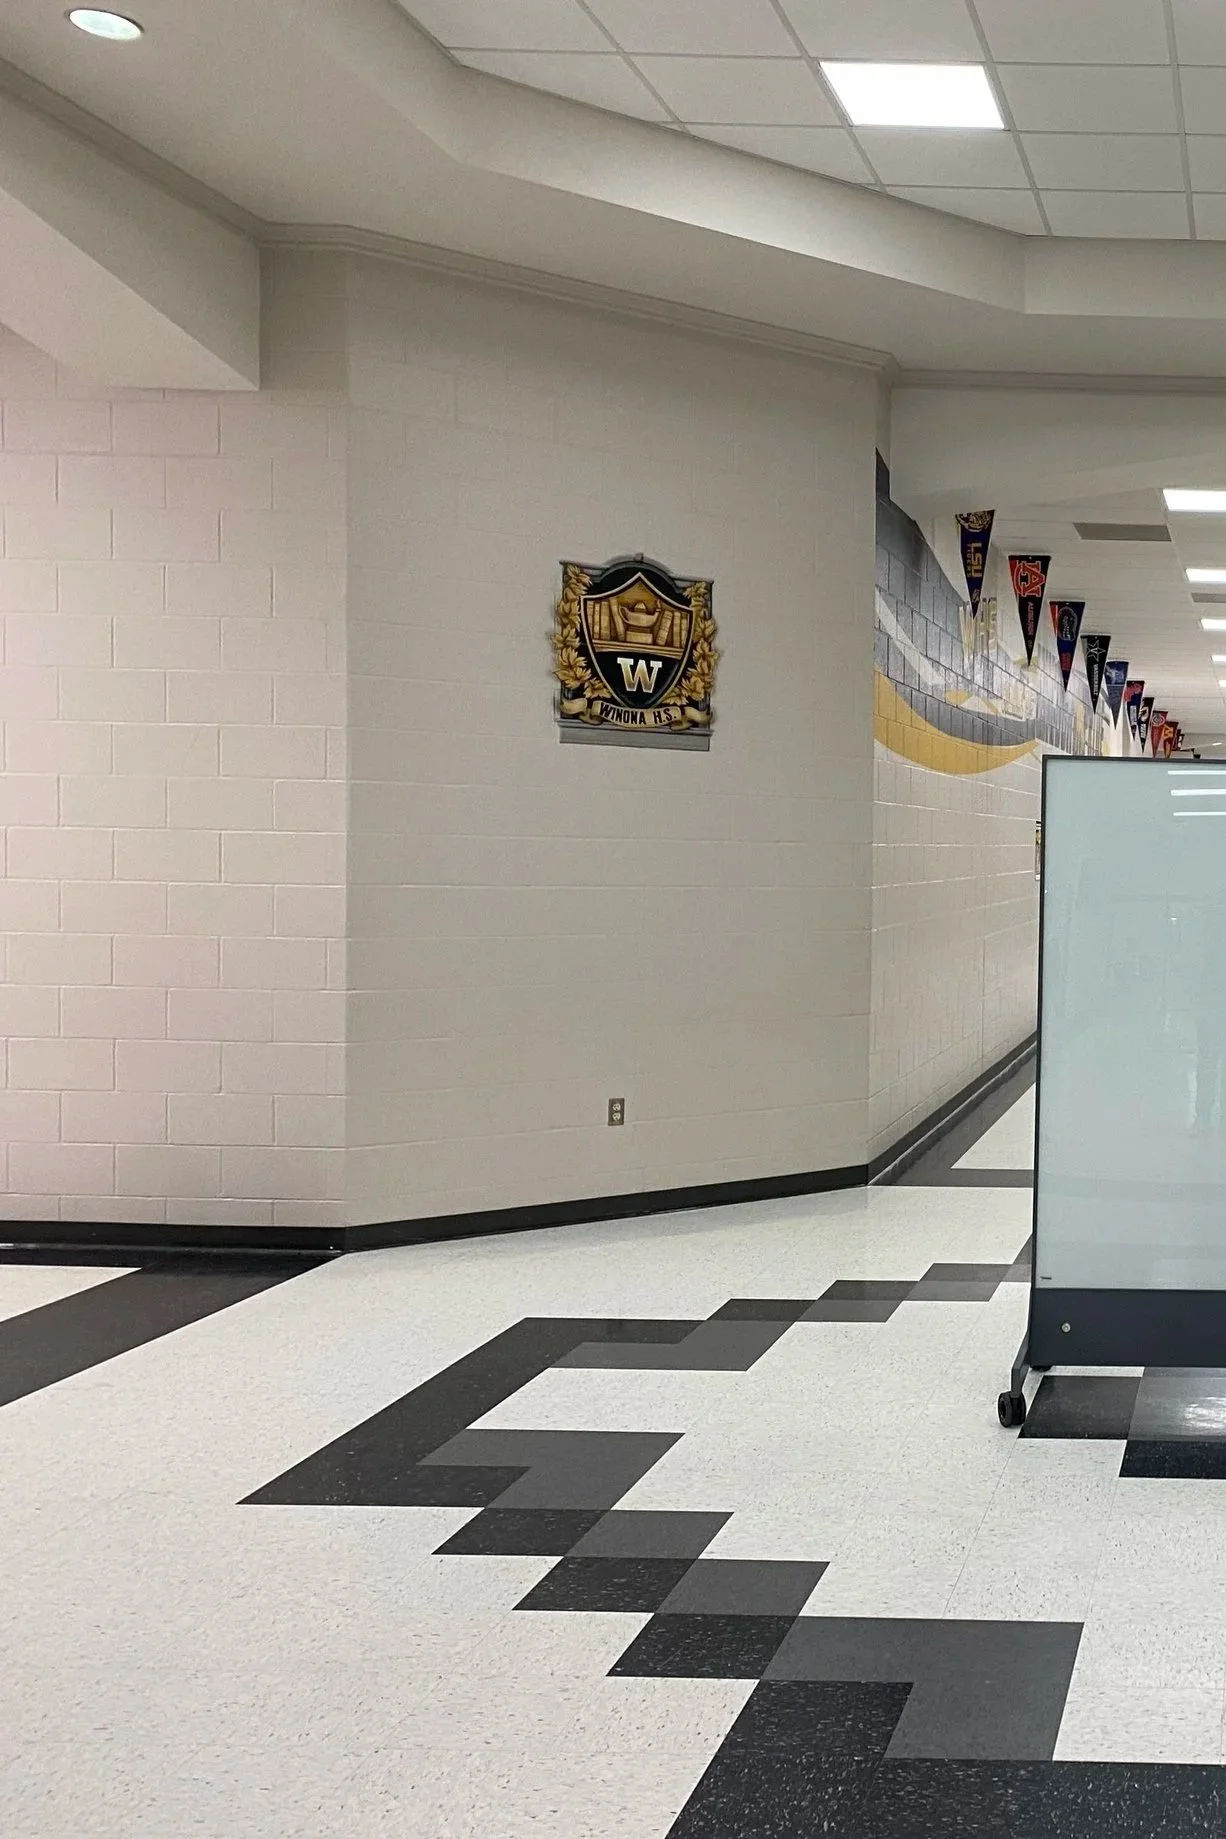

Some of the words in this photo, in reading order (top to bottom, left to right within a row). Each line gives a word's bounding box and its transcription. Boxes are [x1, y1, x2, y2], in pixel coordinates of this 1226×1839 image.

[970, 542, 983, 578] LSU
[617, 657, 662, 693] W
[600, 703, 646, 725] WINONA
[653, 708, 677, 724] H.S.
